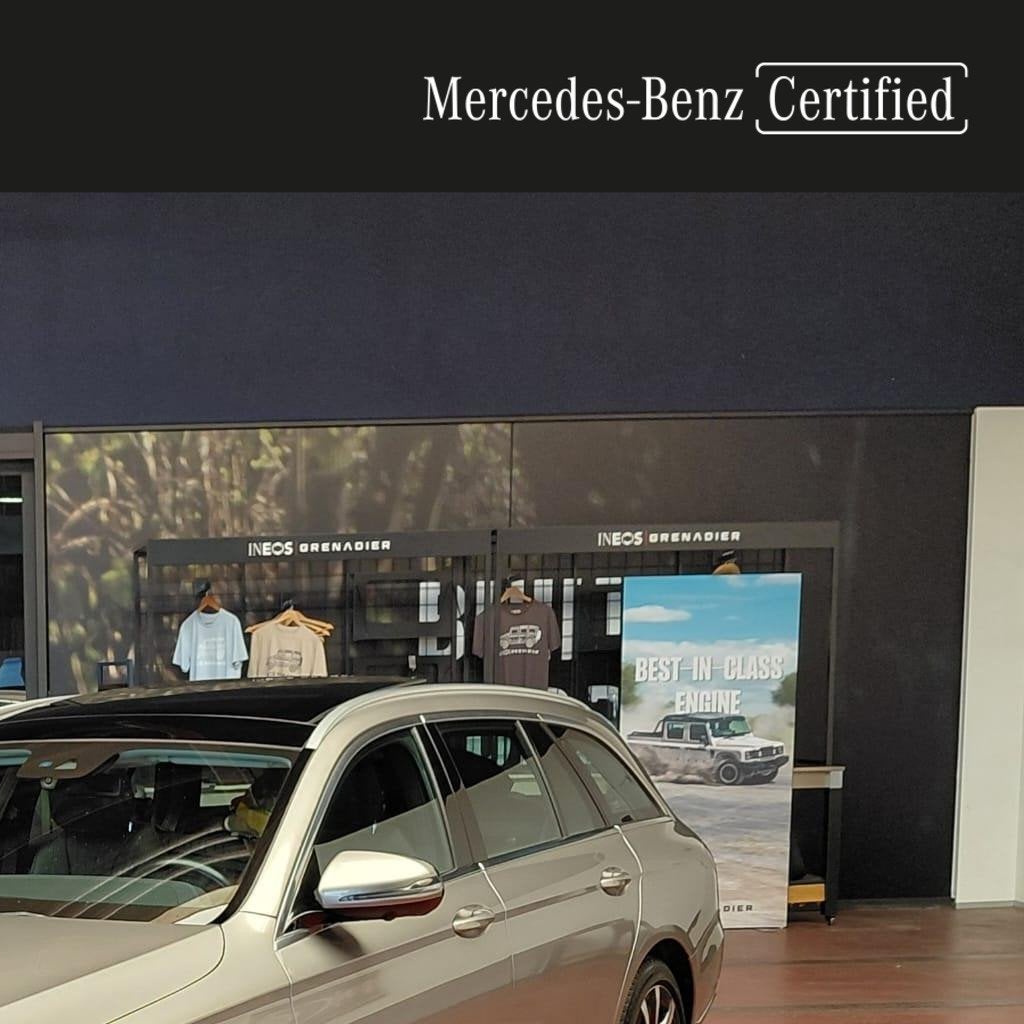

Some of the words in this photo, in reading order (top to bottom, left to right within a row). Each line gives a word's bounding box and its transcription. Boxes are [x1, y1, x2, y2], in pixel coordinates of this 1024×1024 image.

[598, 531, 643, 547] INEOS
[648, 531, 741, 543] GRENADIER
[248, 541, 293, 556] INEOS
[299, 540, 391, 553] GRENADIER
[676, 689, 741, 715] ENGINE
[723, 904, 753, 912] DIER
